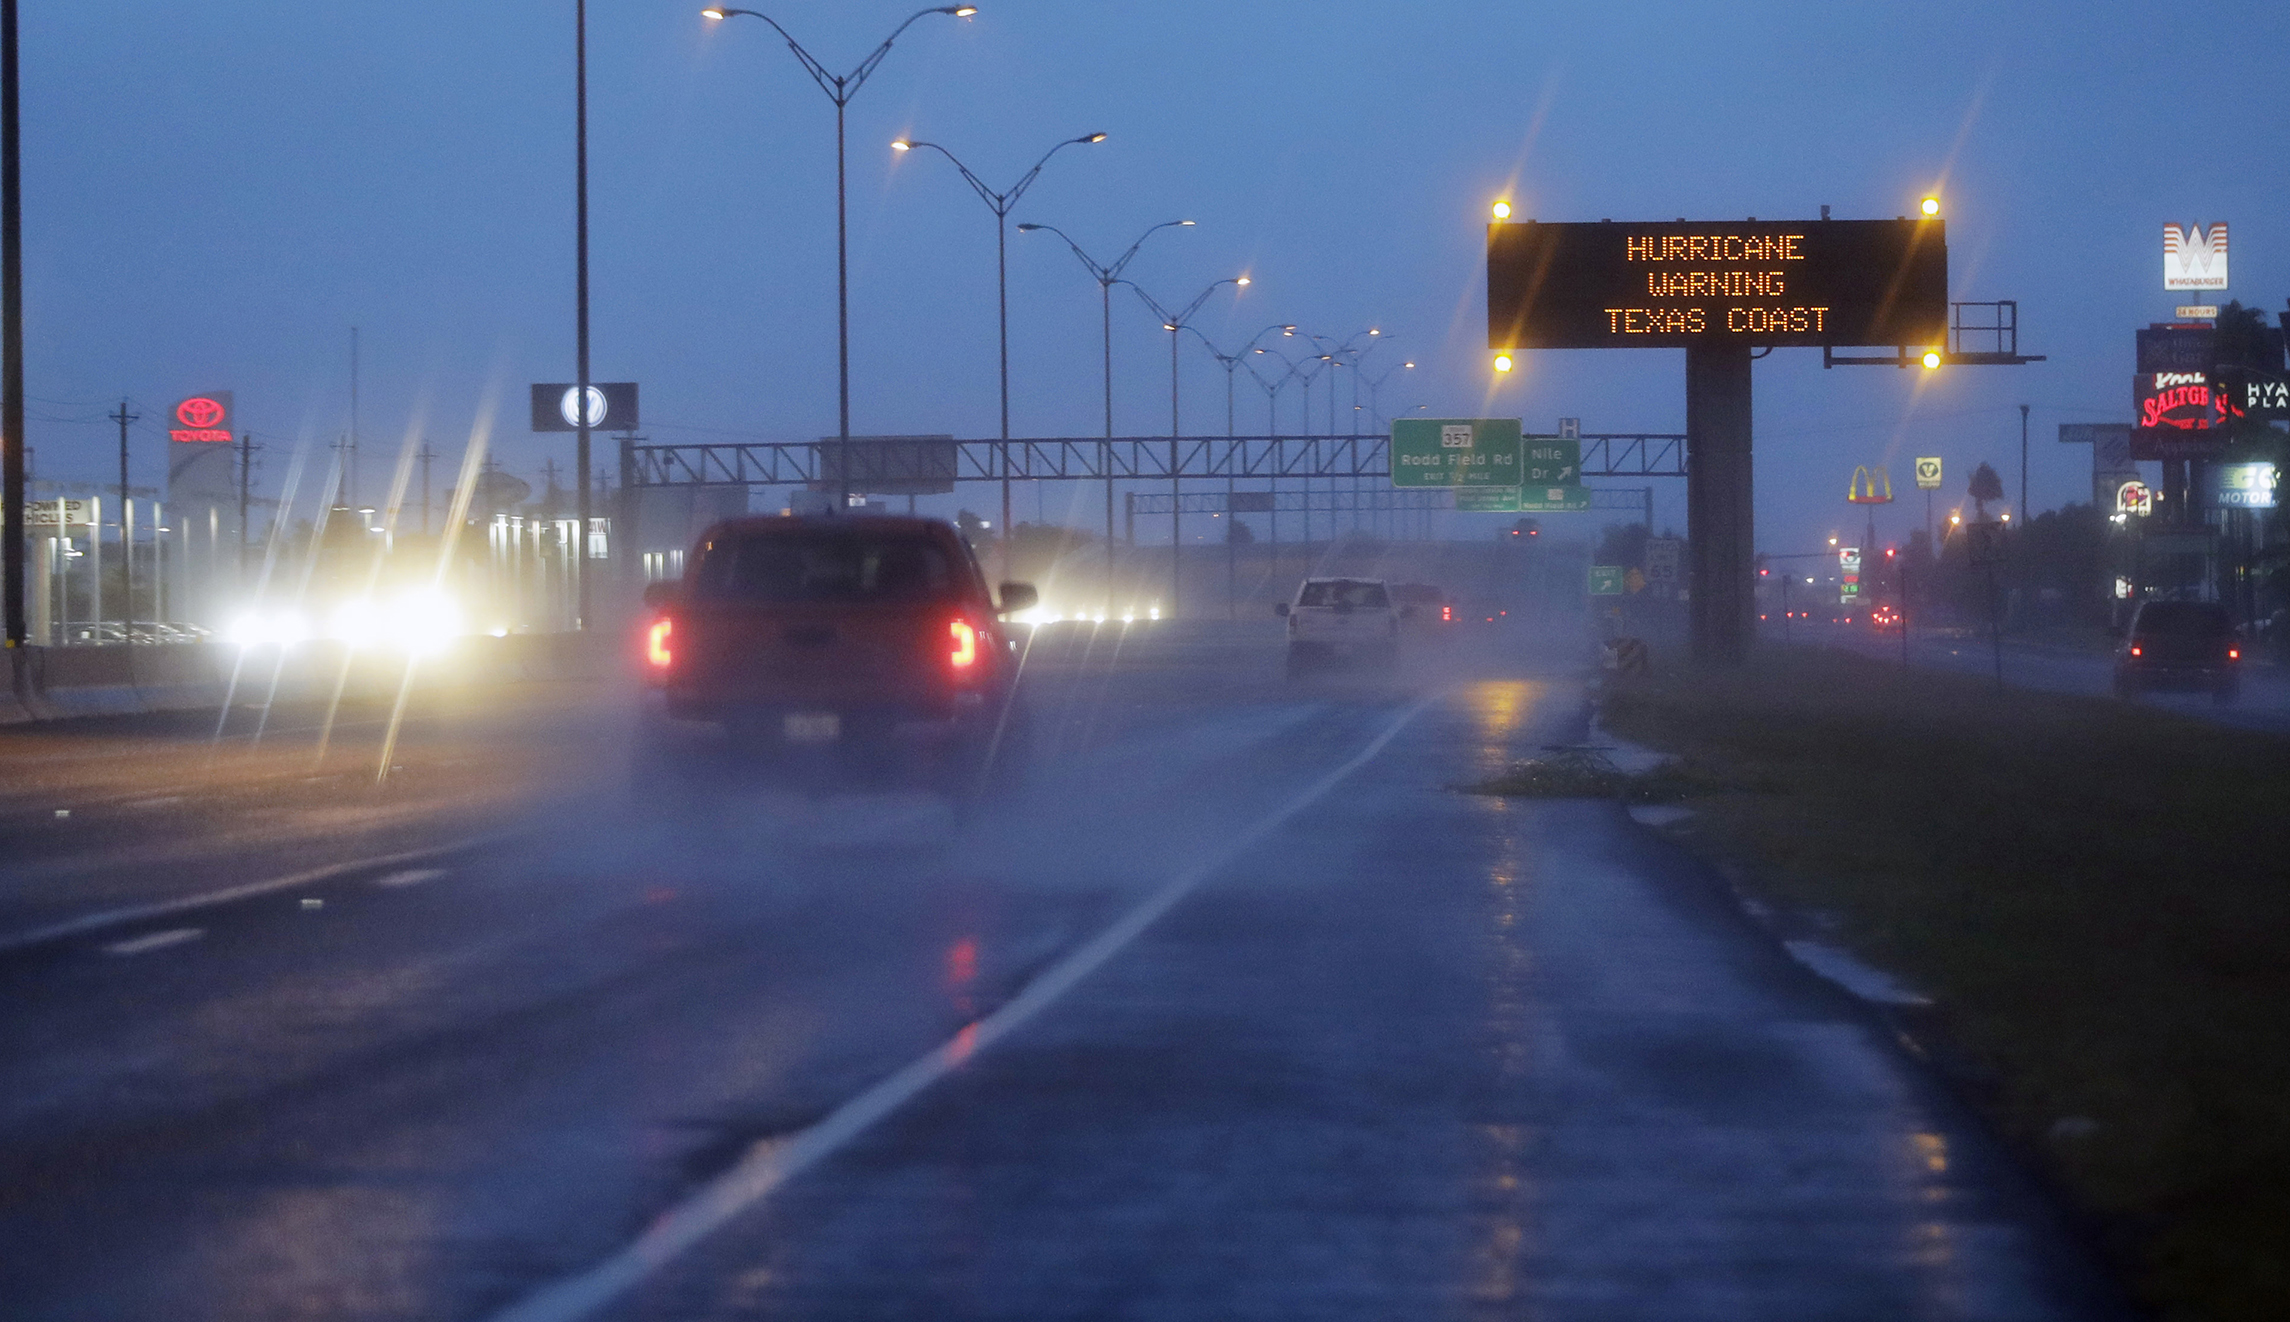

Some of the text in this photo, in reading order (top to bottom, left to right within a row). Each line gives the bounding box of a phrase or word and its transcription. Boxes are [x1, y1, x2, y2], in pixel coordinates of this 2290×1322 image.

[1627, 235, 1805, 261] HURRICANE
[1648, 271, 1785, 297] WARNING
[2168, 278, 2224, 286] WHATABURGER
[2189, 308, 2216, 316] HOURS
[1604, 306, 1829, 333] TEXAS COAST
[168, 430, 233, 442] TOYOTA
[1443, 433, 1471, 446] 357
[1401, 453, 1513, 466] Rodd Field Rd
[1532, 448, 1562, 460] Nile
[1424, 472, 1444, 480] EXIT
[1469, 472, 1491, 480] MILE
[1532, 467, 1549, 480] Dr
[2217, 491, 2277, 505] MOTOR
